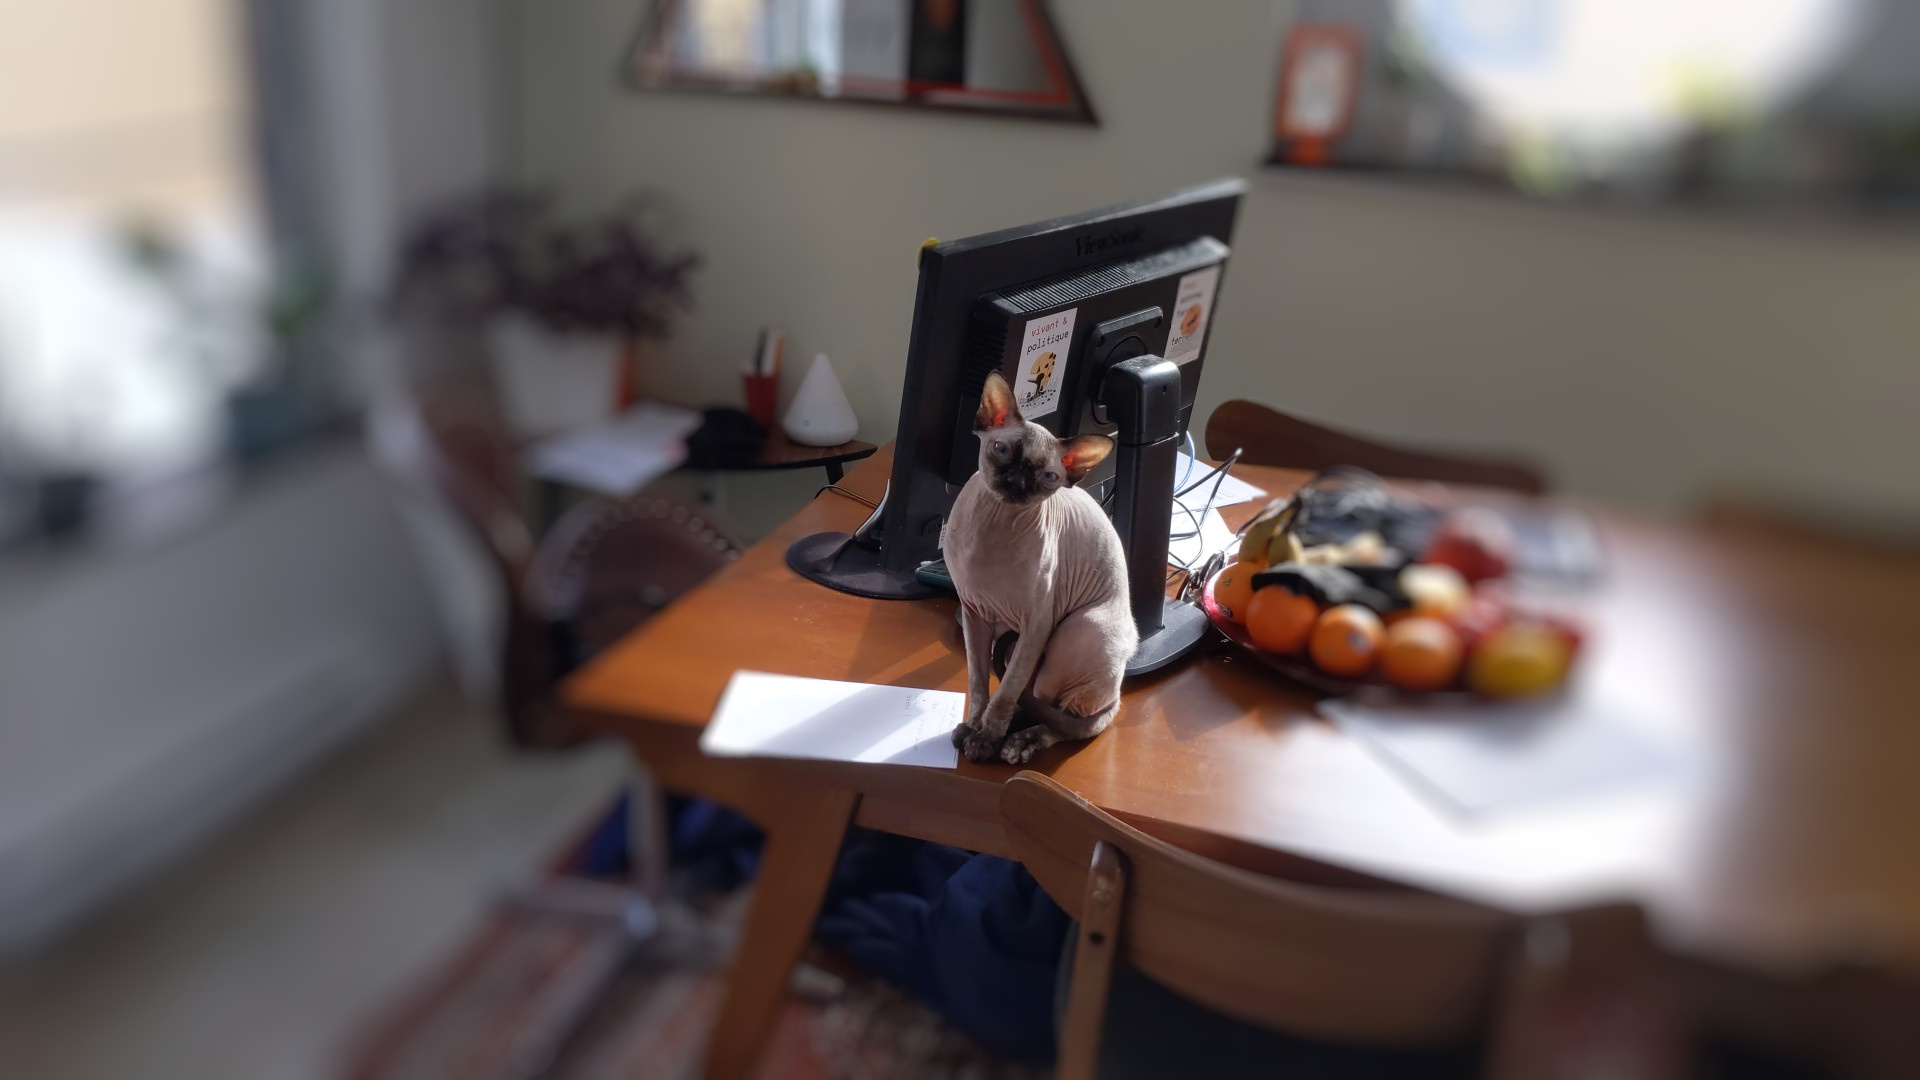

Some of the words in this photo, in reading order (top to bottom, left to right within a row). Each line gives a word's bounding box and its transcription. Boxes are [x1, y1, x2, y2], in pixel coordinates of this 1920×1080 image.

[1031, 319, 1059, 337] vivant
[1062, 316, 1068, 325] &
[1026, 331, 1069, 355] politique
